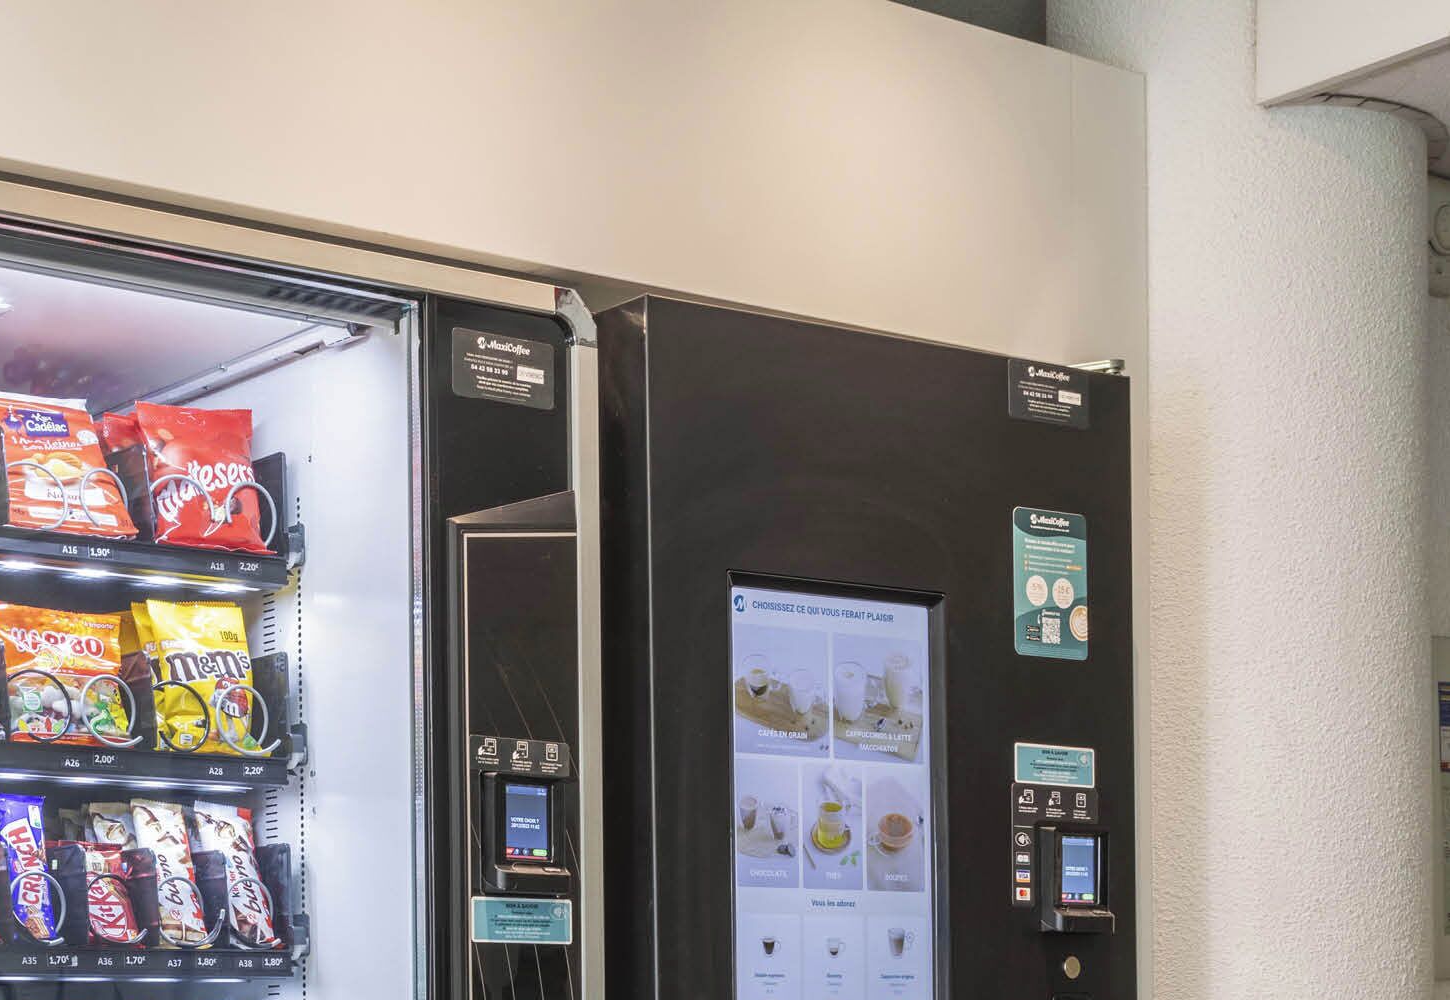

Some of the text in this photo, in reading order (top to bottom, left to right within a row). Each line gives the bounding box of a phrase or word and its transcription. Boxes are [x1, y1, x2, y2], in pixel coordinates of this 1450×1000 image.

[486, 340, 531, 356] MaxiCoffee
[62, 544, 78, 555] A16
[752, 600, 894, 623] CHOISISSEZ CE QUI VOUS FERAIT PLAISIR
[65, 758, 80, 768] A26
[208, 766, 223, 776] A28
[811, 899, 826, 907] Vous
[21, 956, 38, 965] A35
[97, 957, 113, 966] A36
[167, 958, 182, 967] A37
[238, 958, 253, 968] A38
